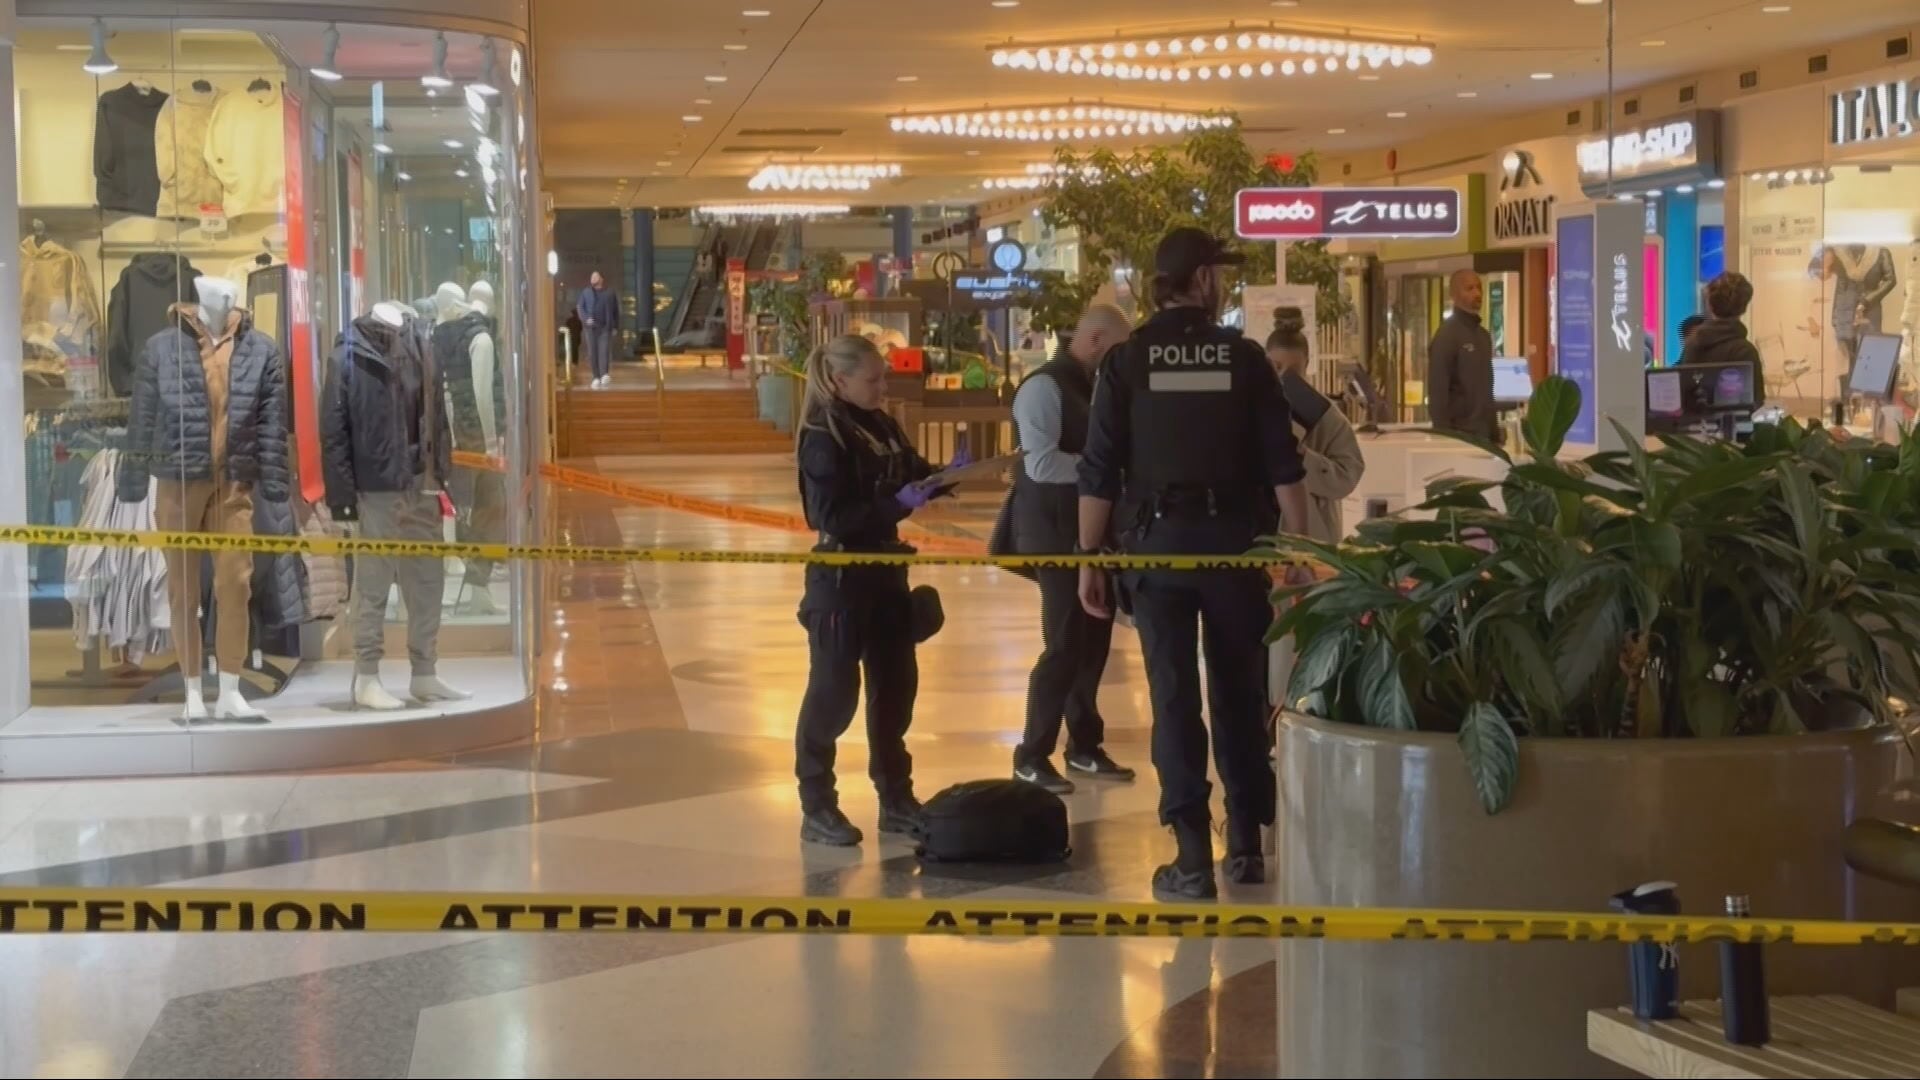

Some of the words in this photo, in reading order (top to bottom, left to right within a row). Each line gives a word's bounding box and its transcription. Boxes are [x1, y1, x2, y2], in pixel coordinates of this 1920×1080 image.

[1375, 202, 1448, 219] TELUS
[1613, 254, 1628, 314] TELUS
[1148, 344, 1232, 365] POLICE
[439, 904, 851, 930] ATTENTION
